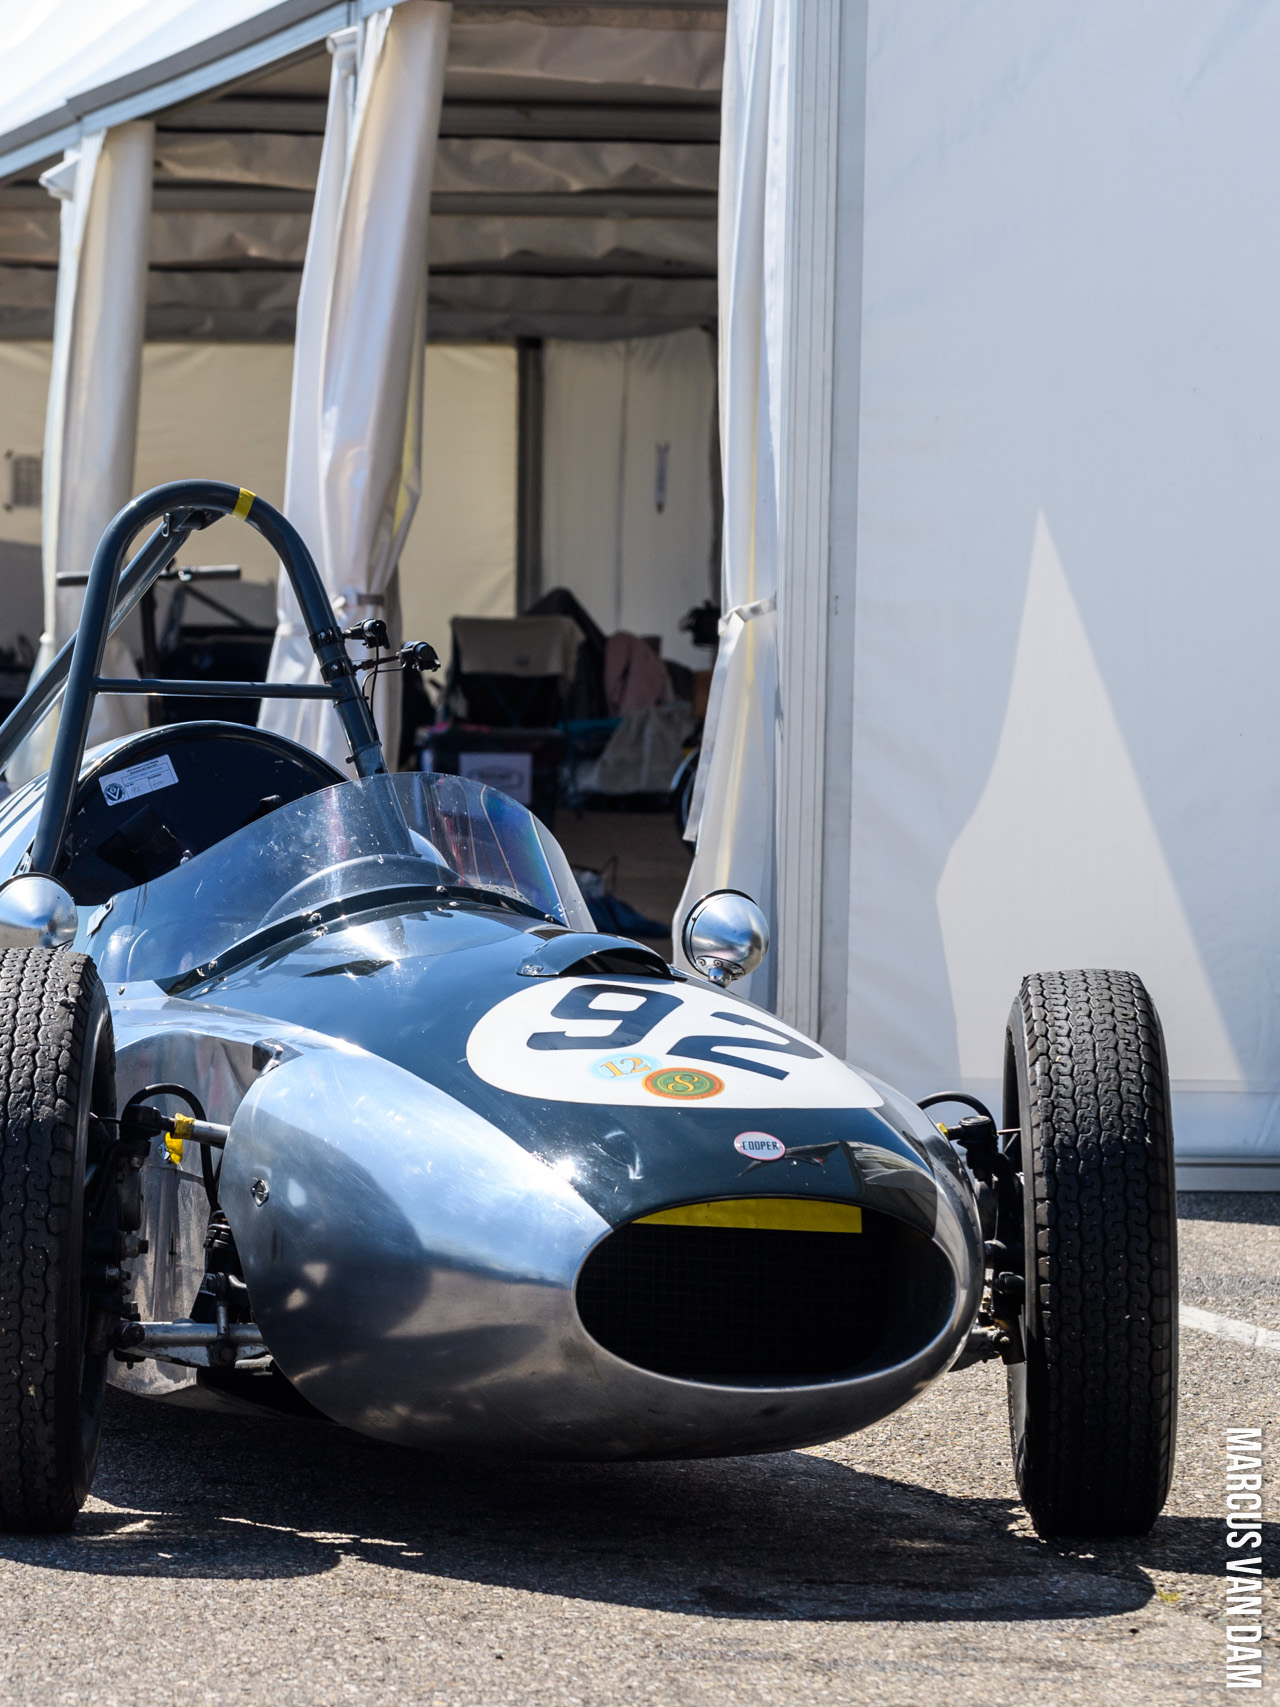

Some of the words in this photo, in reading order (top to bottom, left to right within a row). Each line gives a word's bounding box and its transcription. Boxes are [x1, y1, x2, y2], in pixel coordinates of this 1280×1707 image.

[526, 984, 824, 1081] 92
[600, 1057, 652, 1078] 12
[666, 1073, 699, 1092] 8
[742, 1140, 780, 1151] COOPER
